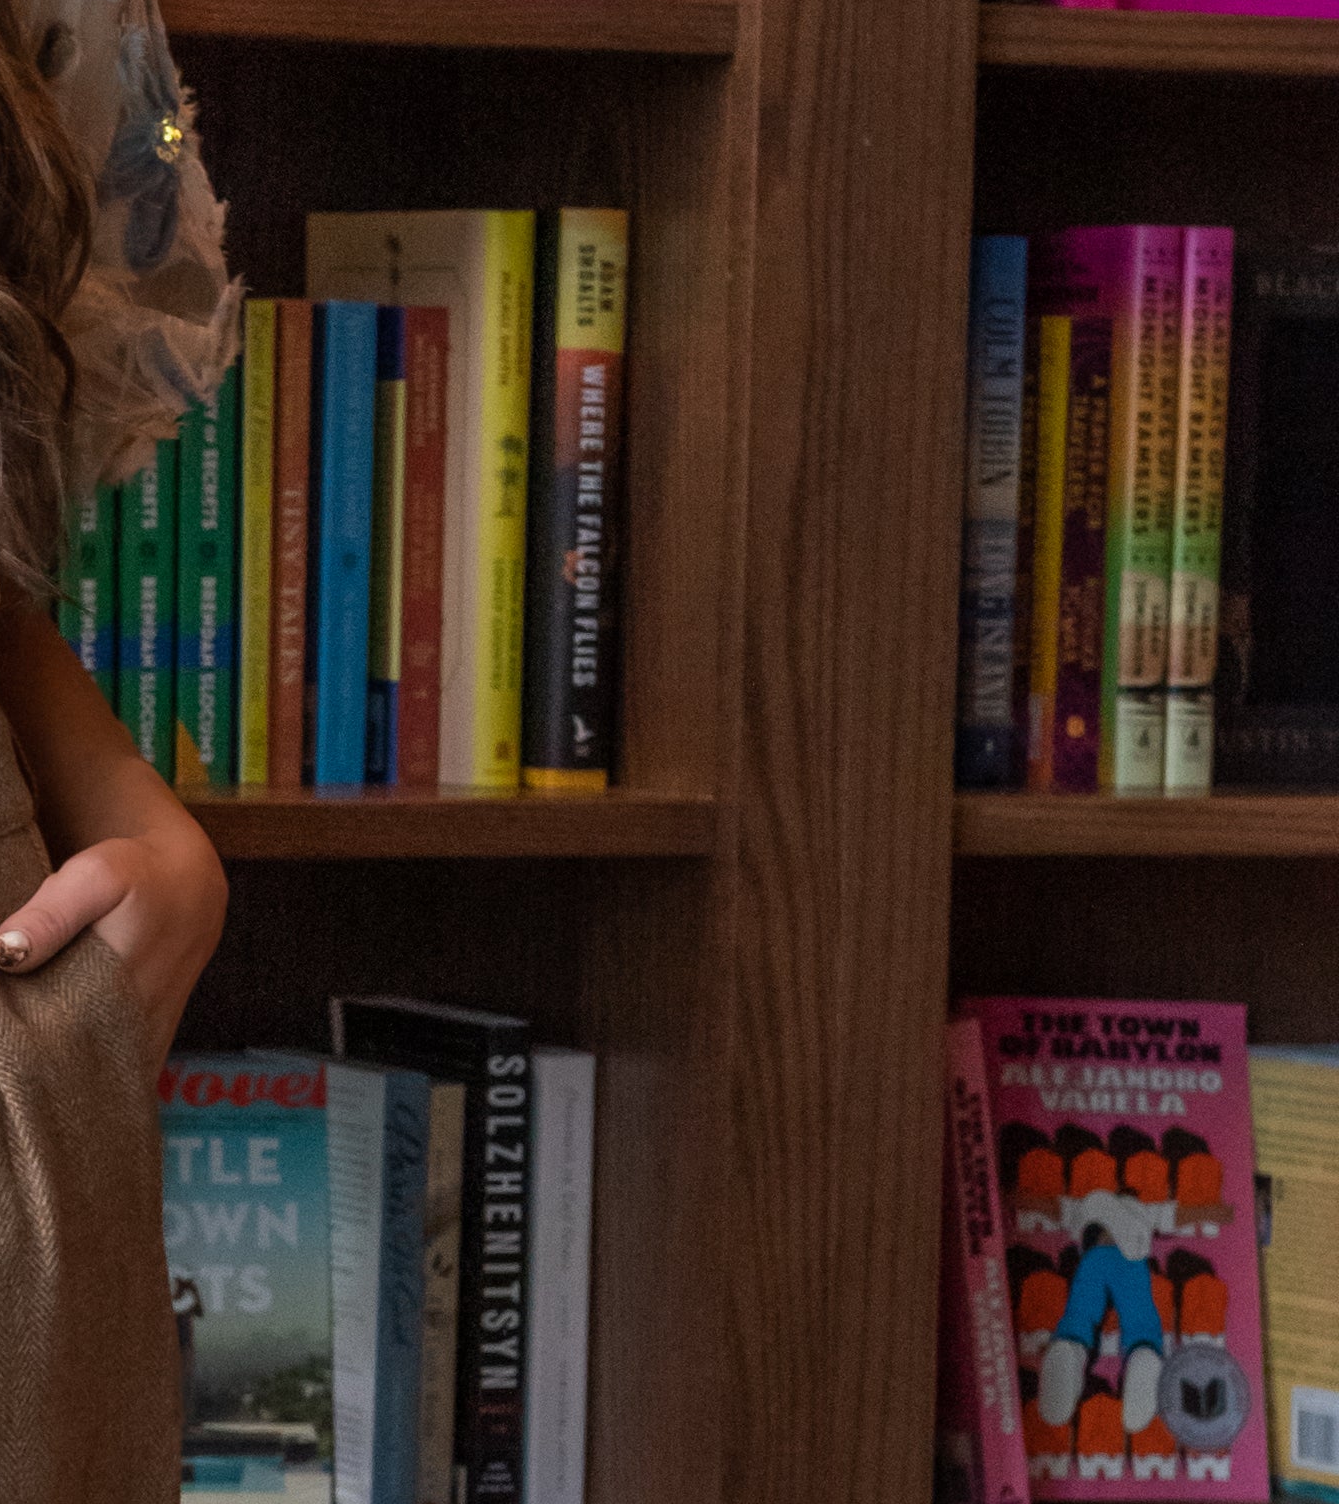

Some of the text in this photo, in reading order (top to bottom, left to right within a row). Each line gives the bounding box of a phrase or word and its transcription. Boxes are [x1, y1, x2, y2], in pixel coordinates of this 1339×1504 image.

[571, 364, 606, 688] WHERE THE FALCON FLIES
[1101, 1014, 1200, 1038] TOWN
[479, 1053, 527, 1393] SOLZHENITSYN
